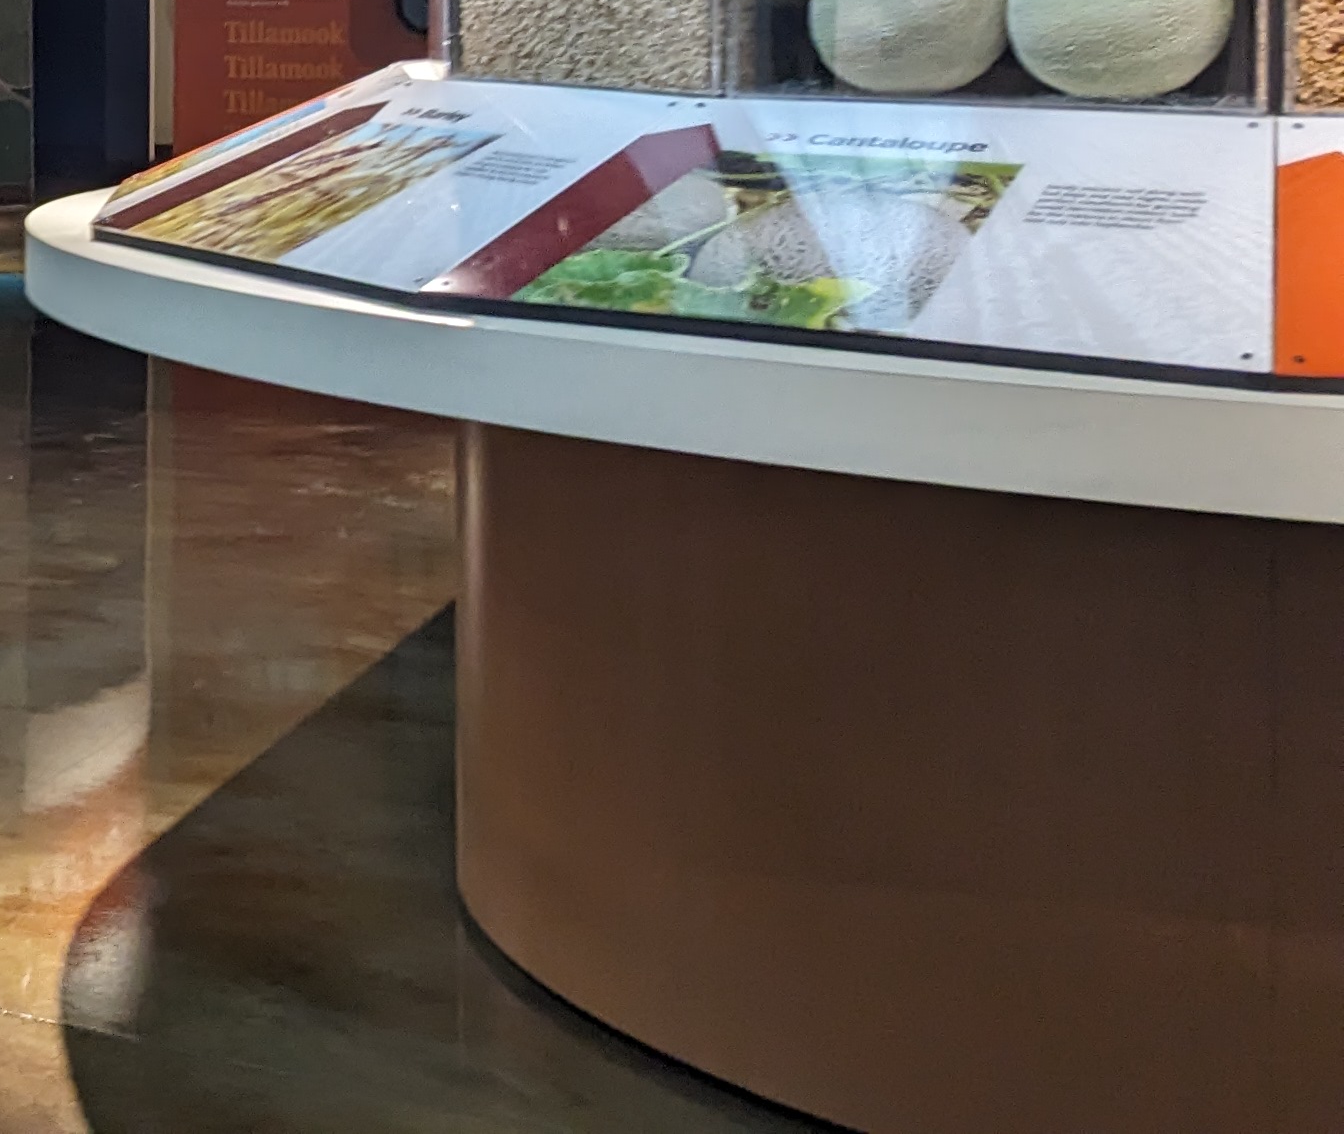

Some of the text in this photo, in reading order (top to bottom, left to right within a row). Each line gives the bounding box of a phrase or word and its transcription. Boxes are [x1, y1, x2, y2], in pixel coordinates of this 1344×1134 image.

[224, 19, 346, 44] Tillamook
[223, 53, 344, 80] Tillamook
[809, 133, 989, 154] Cantaloupe
